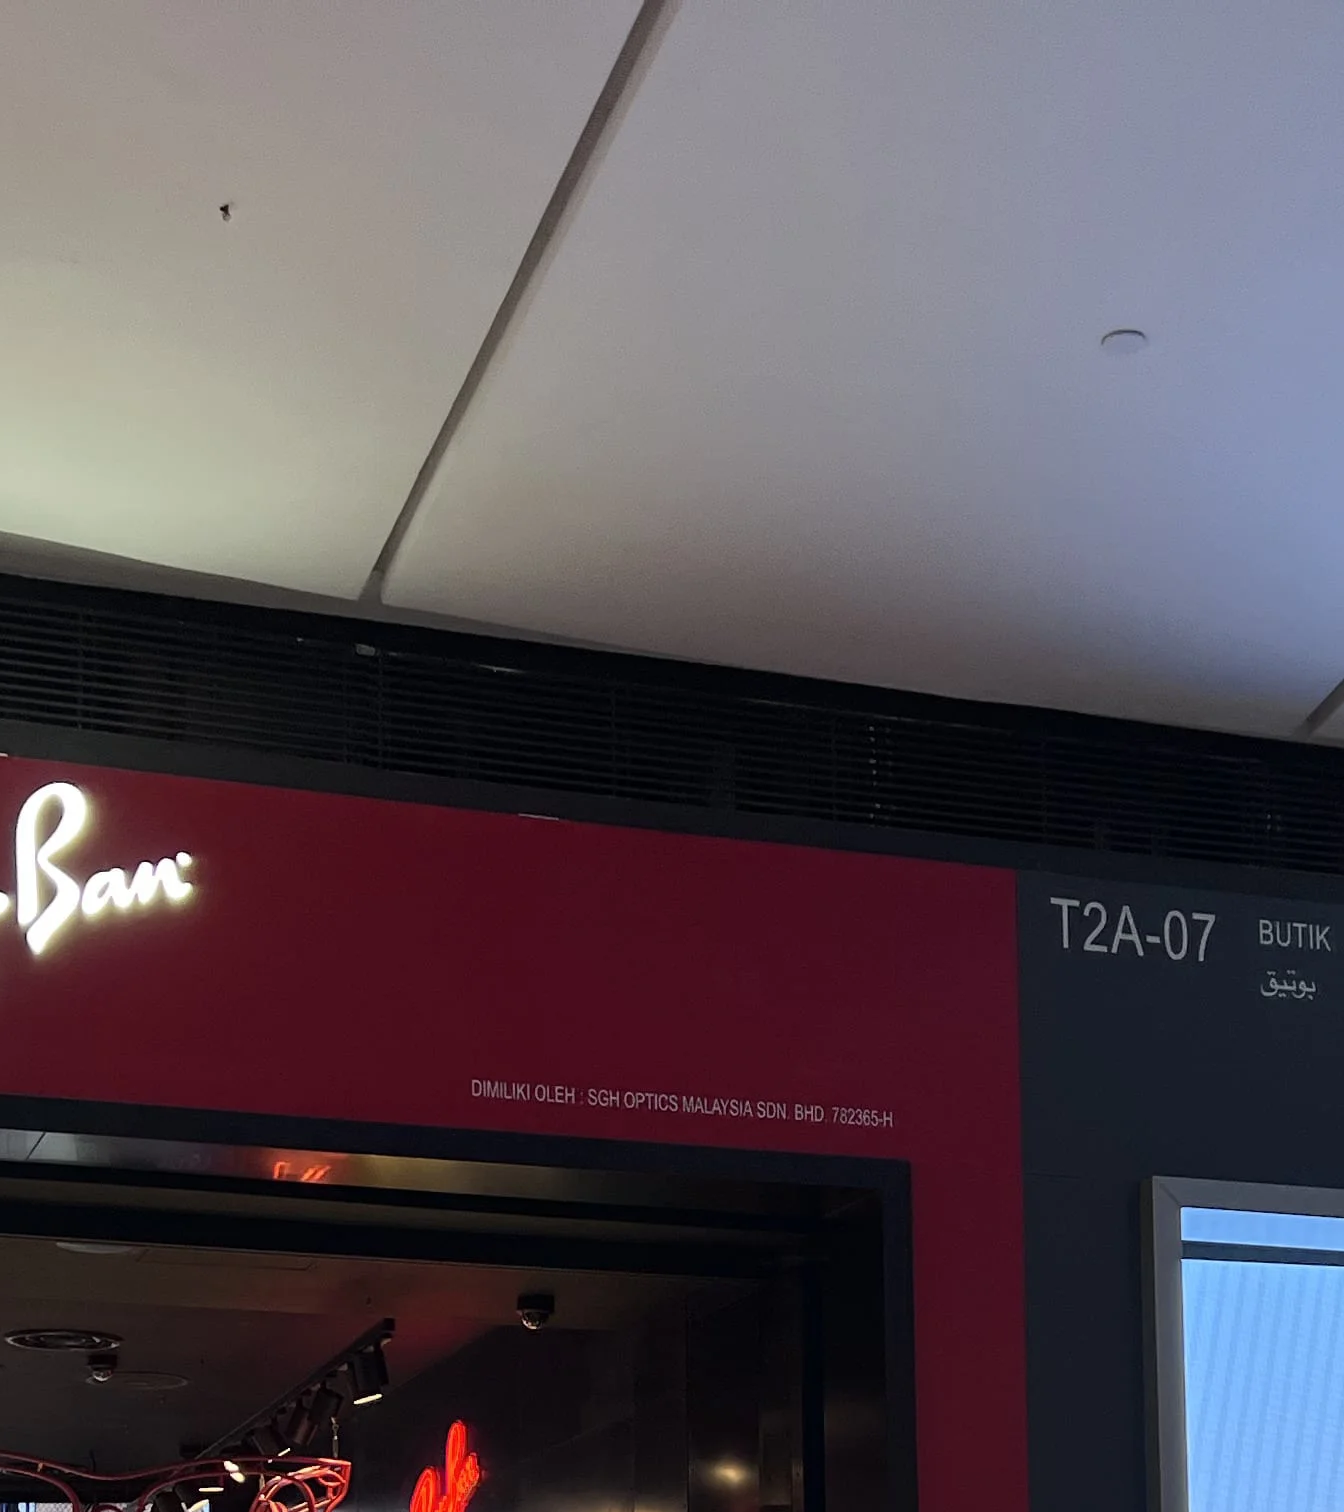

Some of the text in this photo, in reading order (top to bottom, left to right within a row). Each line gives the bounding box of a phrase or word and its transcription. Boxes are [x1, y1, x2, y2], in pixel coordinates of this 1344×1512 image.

[1050, 897, 1216, 962] T2A-07
[1259, 919, 1331, 952] BUTIK
[471, 1079, 531, 1101] DIMILIKI
[535, 1085, 575, 1104] OLEH
[587, 1088, 619, 1108] SGH
[623, 1091, 678, 1112] OPTICS
[682, 1095, 753, 1118] MALAYSIA
[832, 1107, 894, 1128] 782365-H
